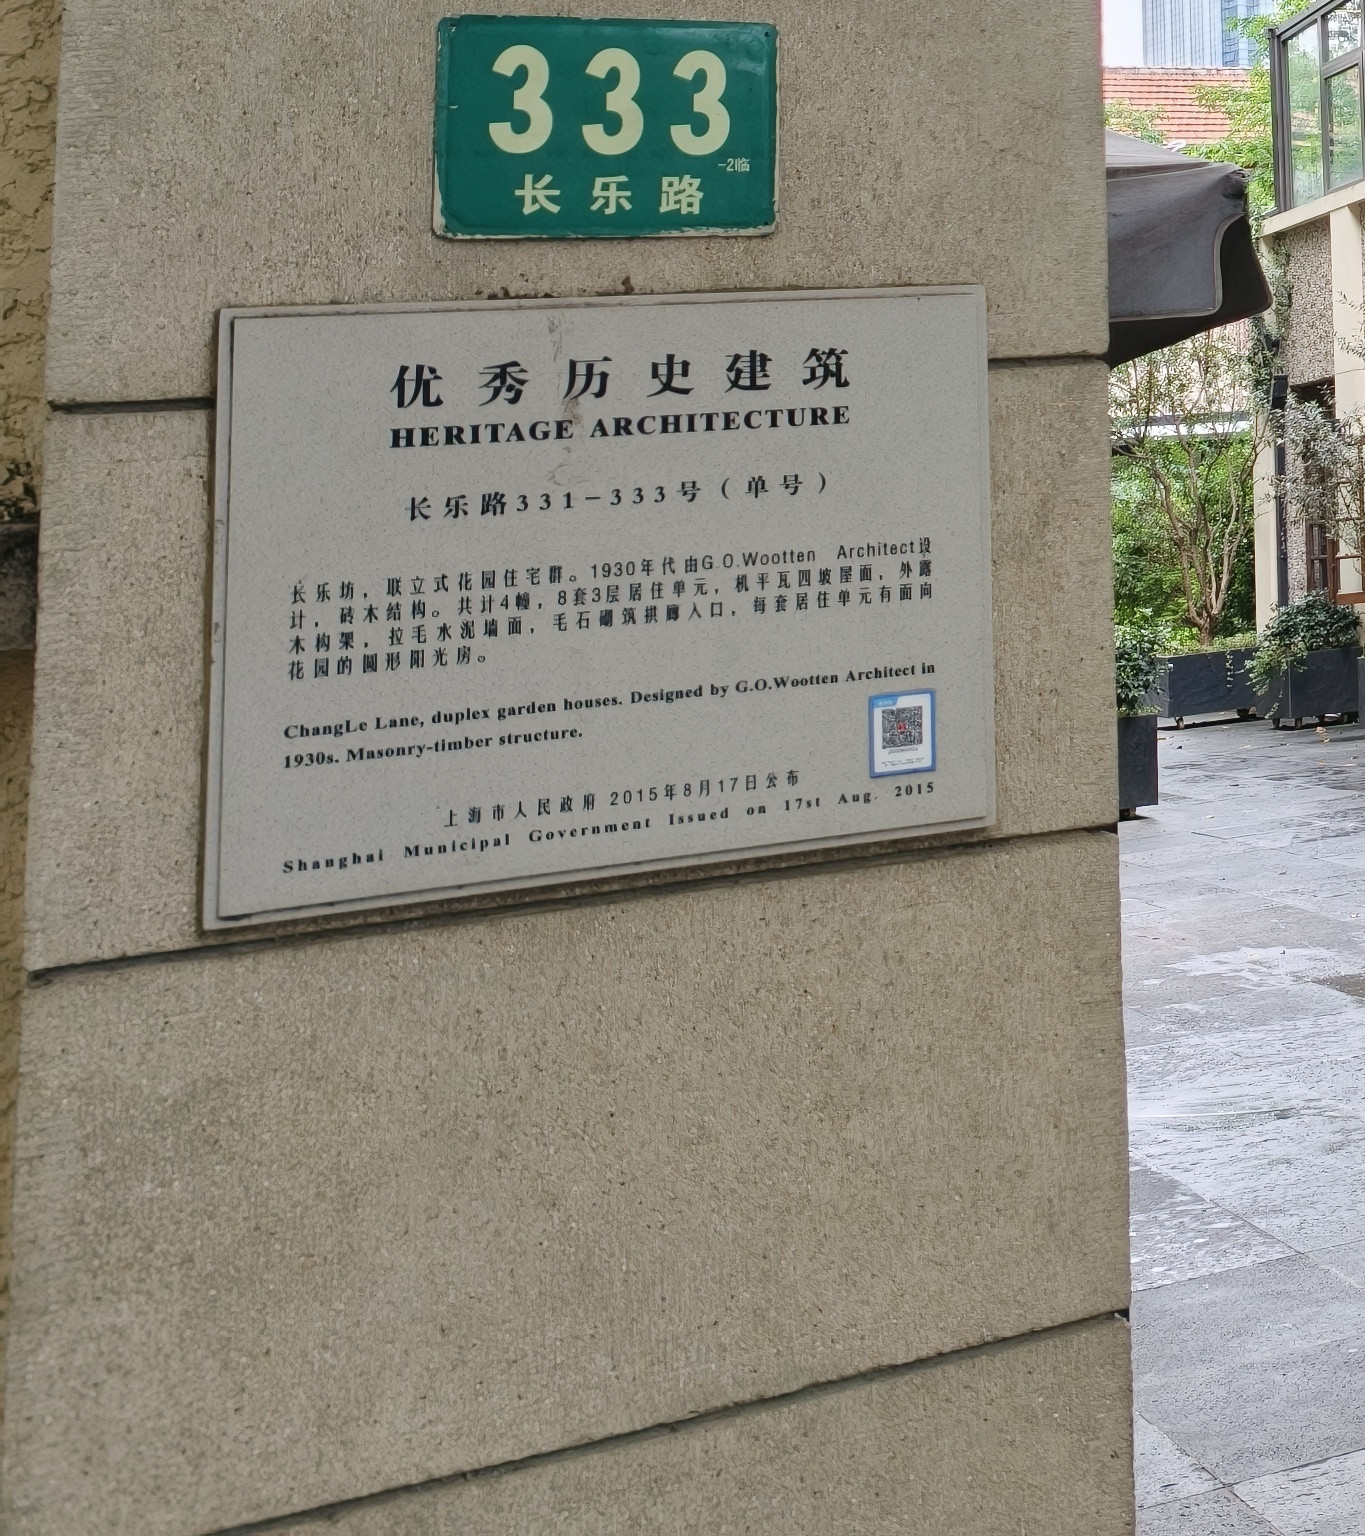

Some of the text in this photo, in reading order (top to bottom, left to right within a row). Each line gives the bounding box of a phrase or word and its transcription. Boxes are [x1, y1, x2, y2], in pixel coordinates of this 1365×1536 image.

[488, 44, 731, 156] 333
[514, 173, 704, 216] 长乐路
[390, 347, 850, 409] 优秀历史建筑
[388, 405, 851, 449] HERITAGE ARCHITECTURE
[283, 661, 936, 739] ChangLe Lane, duplex garden houses. Designed by G.O.Wootten Architect in
[283, 725, 583, 769] 1930s. Masonry-timber structure.
[282, 848, 384, 874] Shanghai
[403, 833, 511, 859] Municipal
[528, 817, 652, 843] Government
[668, 807, 730, 826] Issued
[746, 803, 767, 817] on
[784, 797, 821, 811] 17st
[894, 781, 935, 798] 2015
[443, 768, 800, 828] 上海市人民政府 2015年8月17日公布
